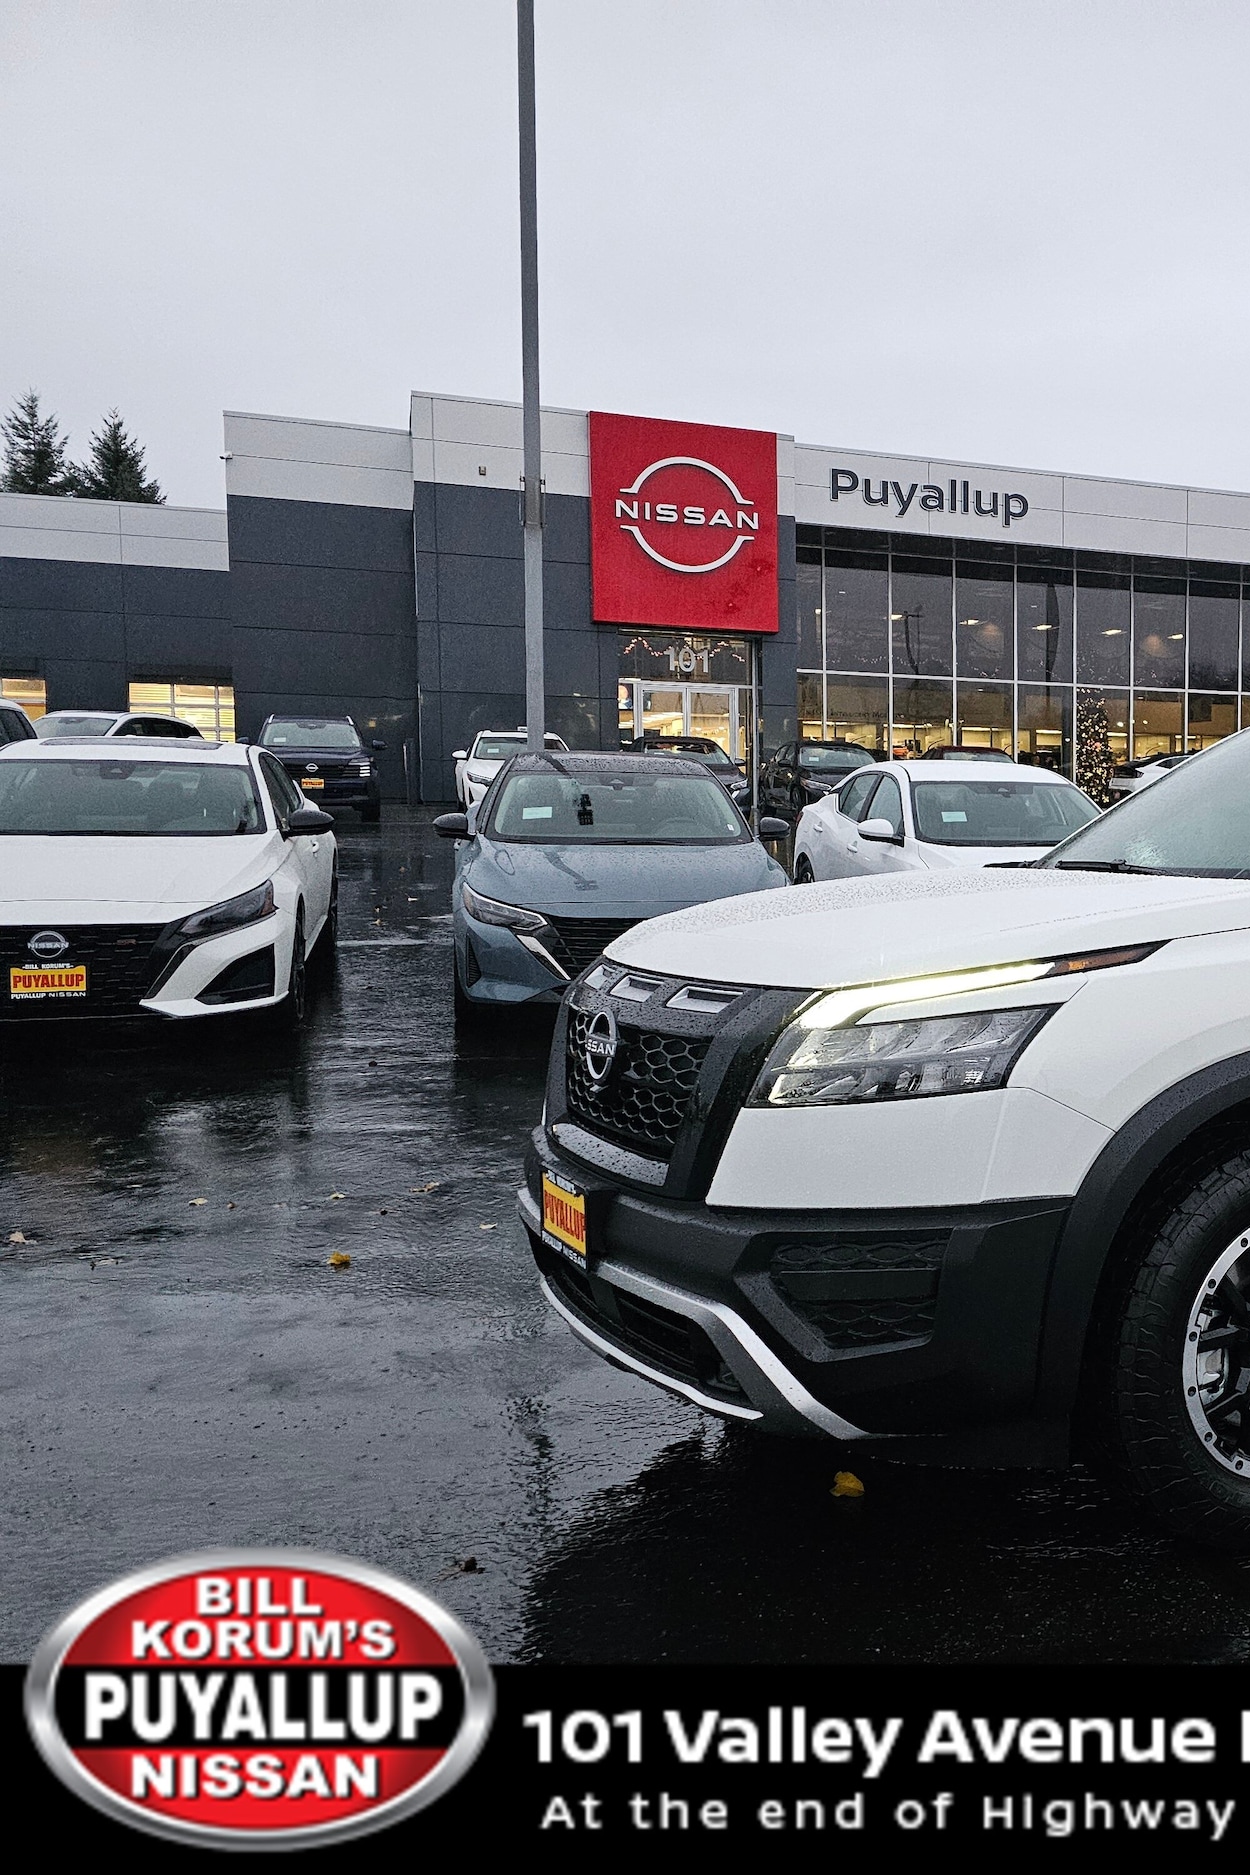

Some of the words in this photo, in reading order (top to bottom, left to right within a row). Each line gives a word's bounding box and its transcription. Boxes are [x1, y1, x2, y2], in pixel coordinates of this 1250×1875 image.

[830, 468, 1029, 528] Puyallup
[615, 499, 759, 530] NISSAN
[663, 646, 710, 673] 101
[12, 973, 85, 989] PUYALLUP
[11, 992, 46, 1000] PUYALLUP
